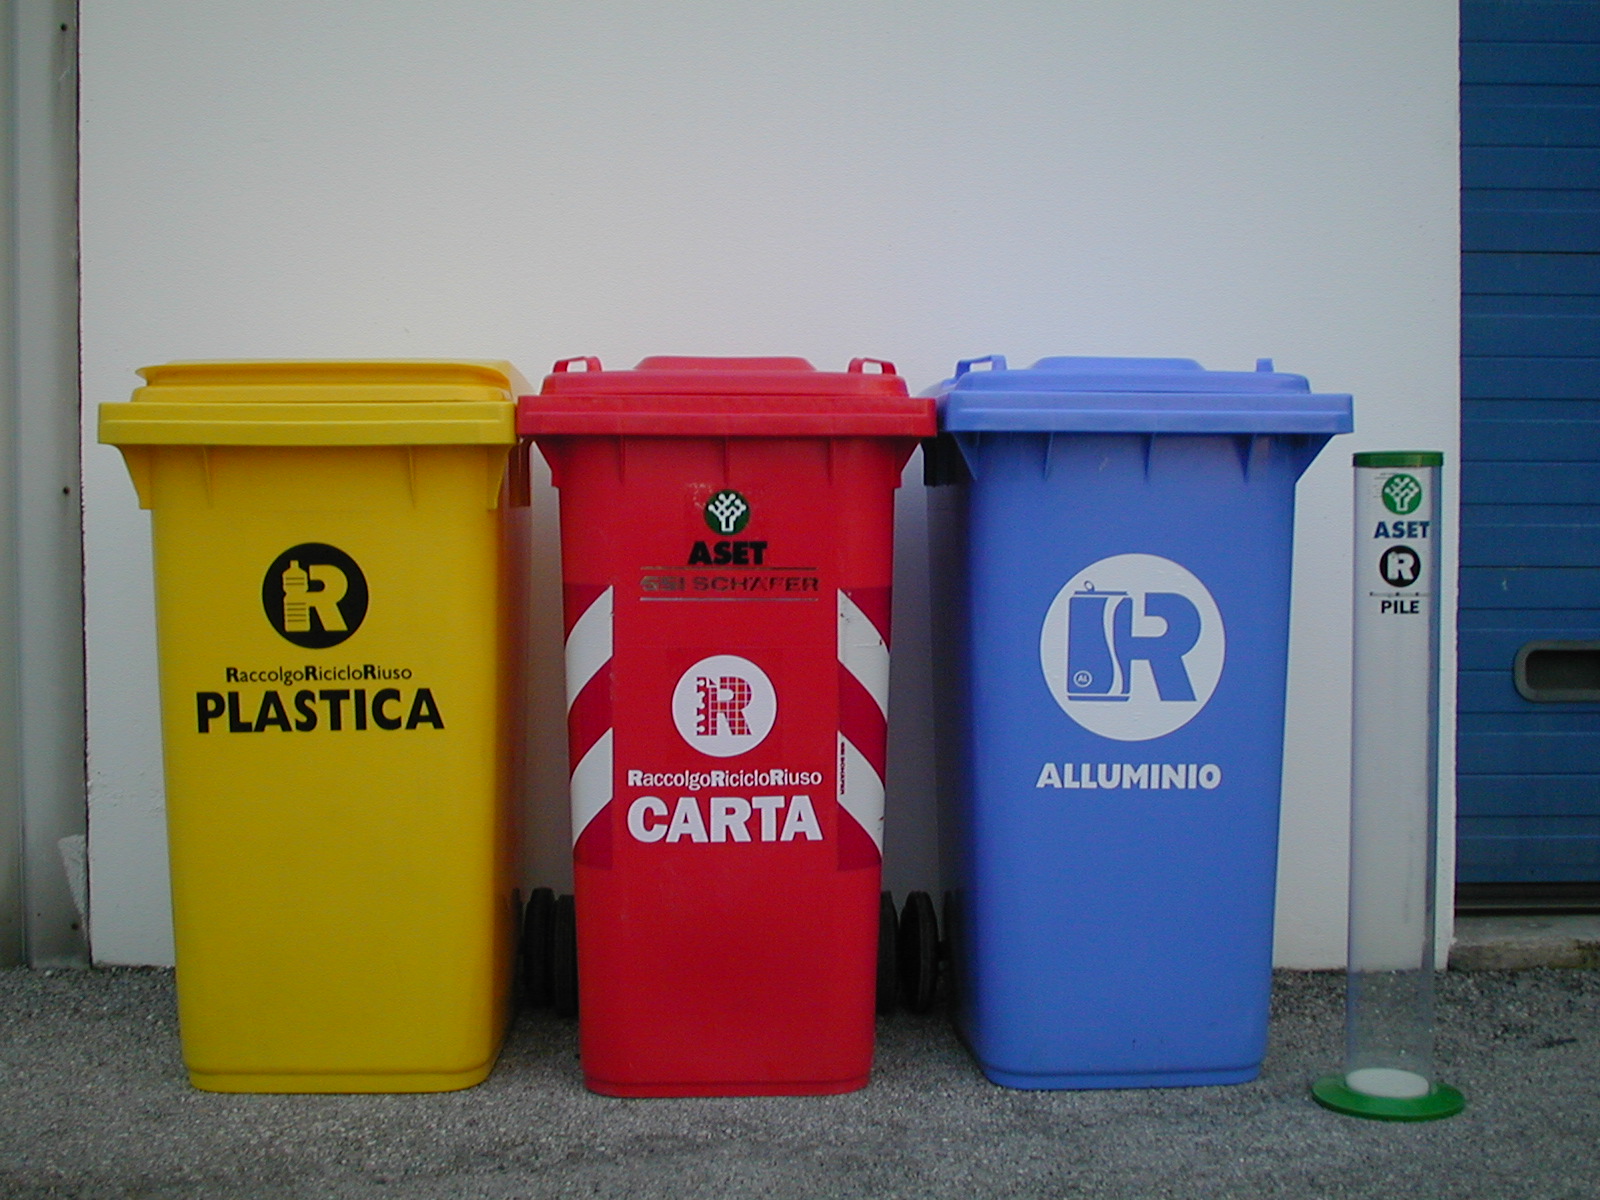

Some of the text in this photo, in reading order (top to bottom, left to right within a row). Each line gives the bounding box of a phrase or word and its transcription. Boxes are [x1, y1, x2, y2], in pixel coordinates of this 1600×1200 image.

[1374, 521, 1430, 539] ASET
[688, 541, 768, 565] ASET
[1381, 600, 1420, 614] PILE
[225, 664, 412, 686] RaccolgoRicicloRiuso
[196, 687, 445, 734] PLASTICA
[628, 768, 823, 791] RaccolgoRicicloRiuso
[1036, 763, 1222, 790] ALLUMINIO
[627, 795, 824, 843] CARTA
